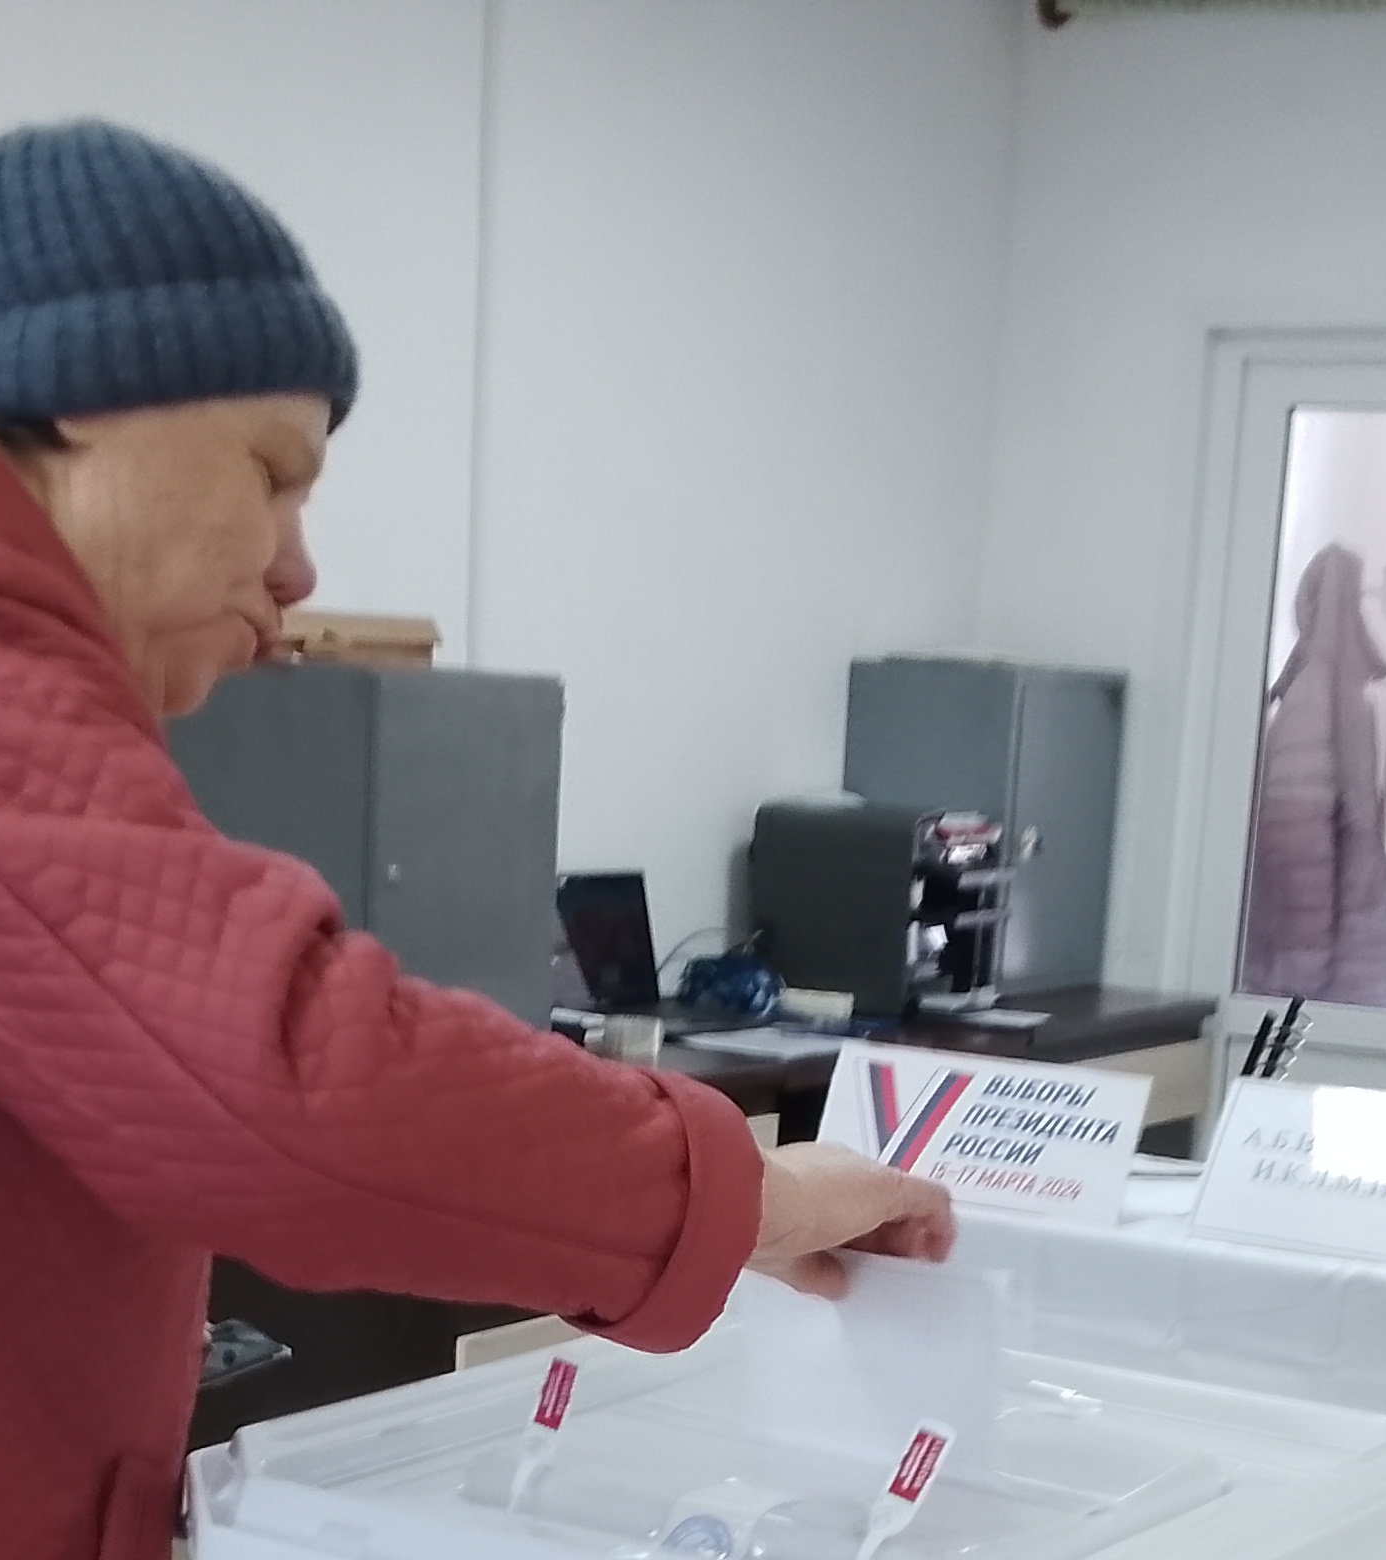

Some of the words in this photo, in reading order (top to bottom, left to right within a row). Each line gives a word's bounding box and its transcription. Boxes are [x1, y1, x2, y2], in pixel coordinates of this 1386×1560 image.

[981, 1073, 1098, 1108] ВЫБОРЫ
[960, 1103, 1122, 1145] ПРЕЗИДЕНТА
[942, 1132, 1047, 1166] РОССИИ
[976, 1169, 1040, 1197] МАРТА
[1037, 1177, 1085, 1201] 2024
